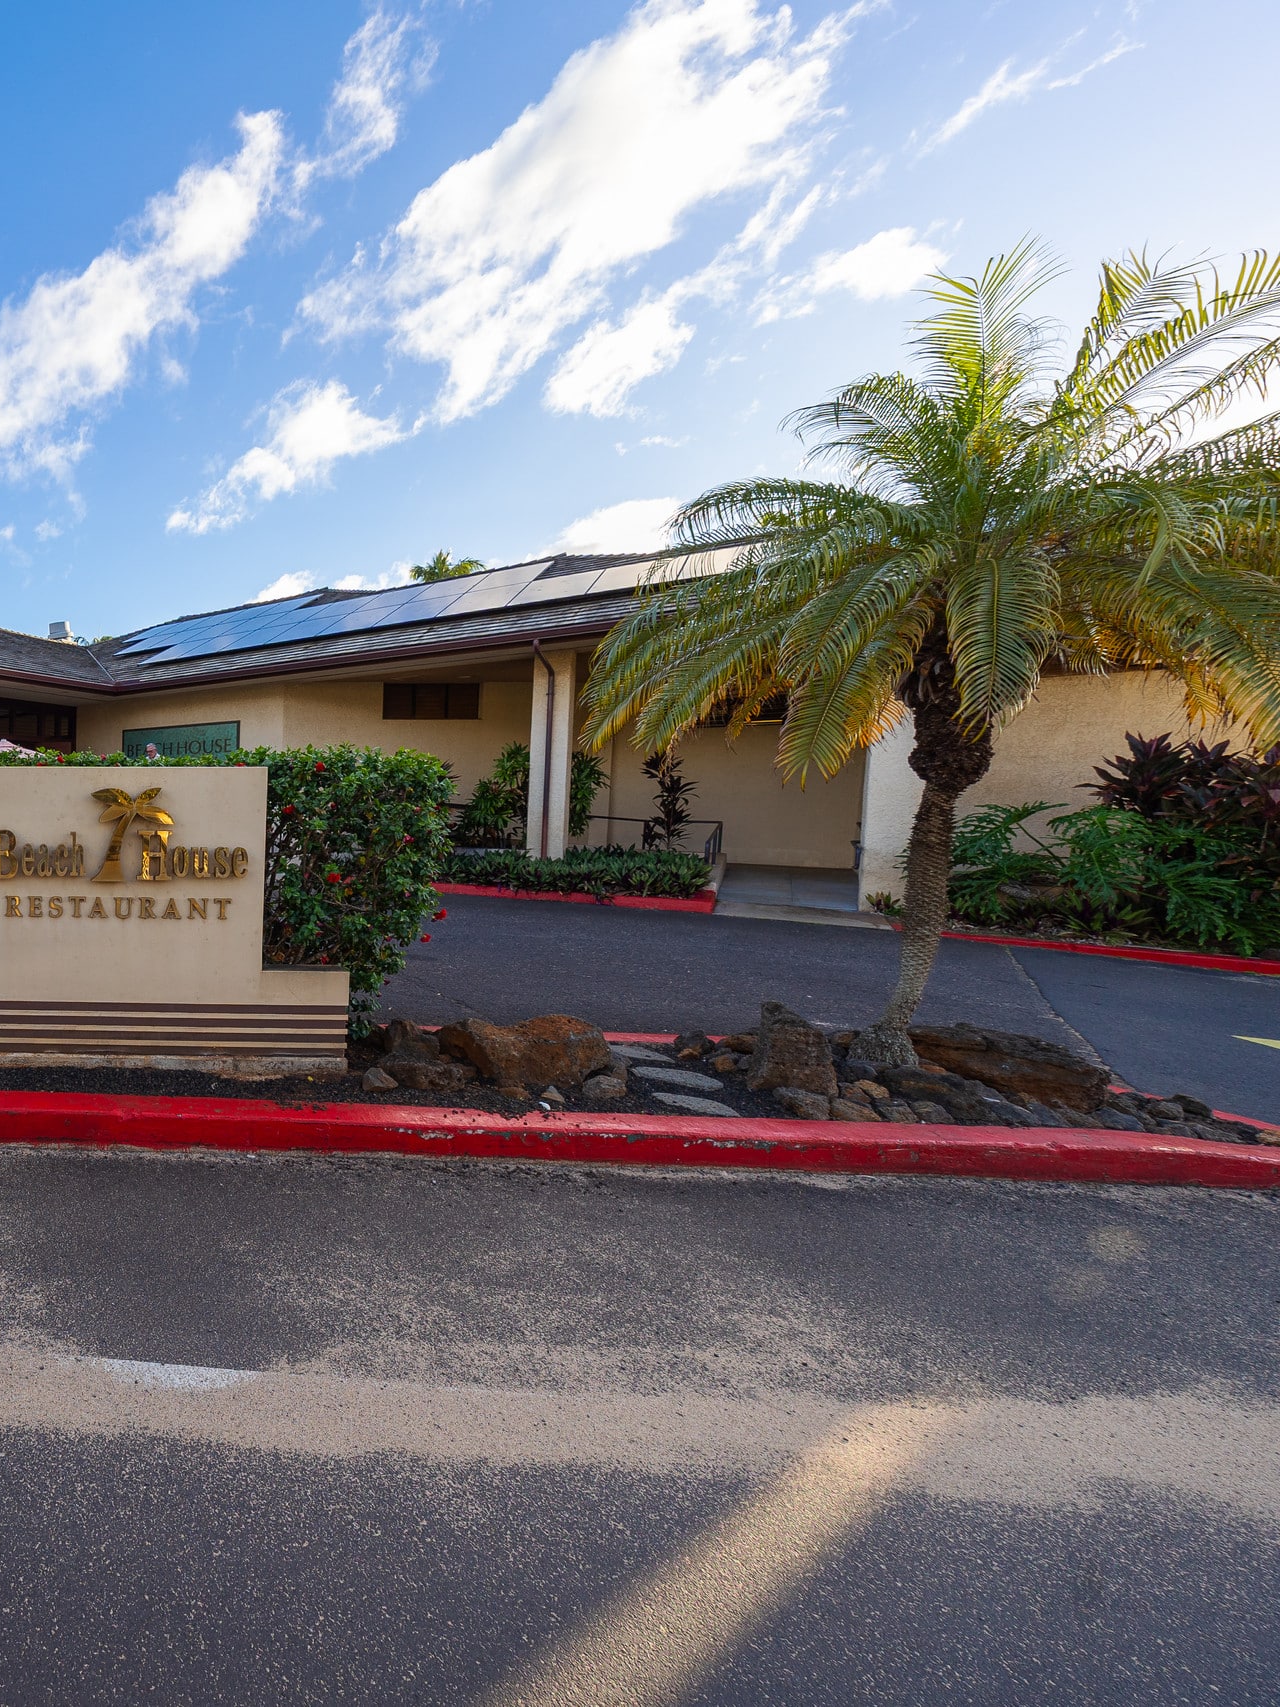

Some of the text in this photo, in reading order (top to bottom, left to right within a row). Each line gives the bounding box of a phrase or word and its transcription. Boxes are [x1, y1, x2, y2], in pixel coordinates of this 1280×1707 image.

[127, 738, 232, 757] BEH HOUSE
[136, 829, 249, 881] House
[4, 895, 233, 920] RESTAURANT
